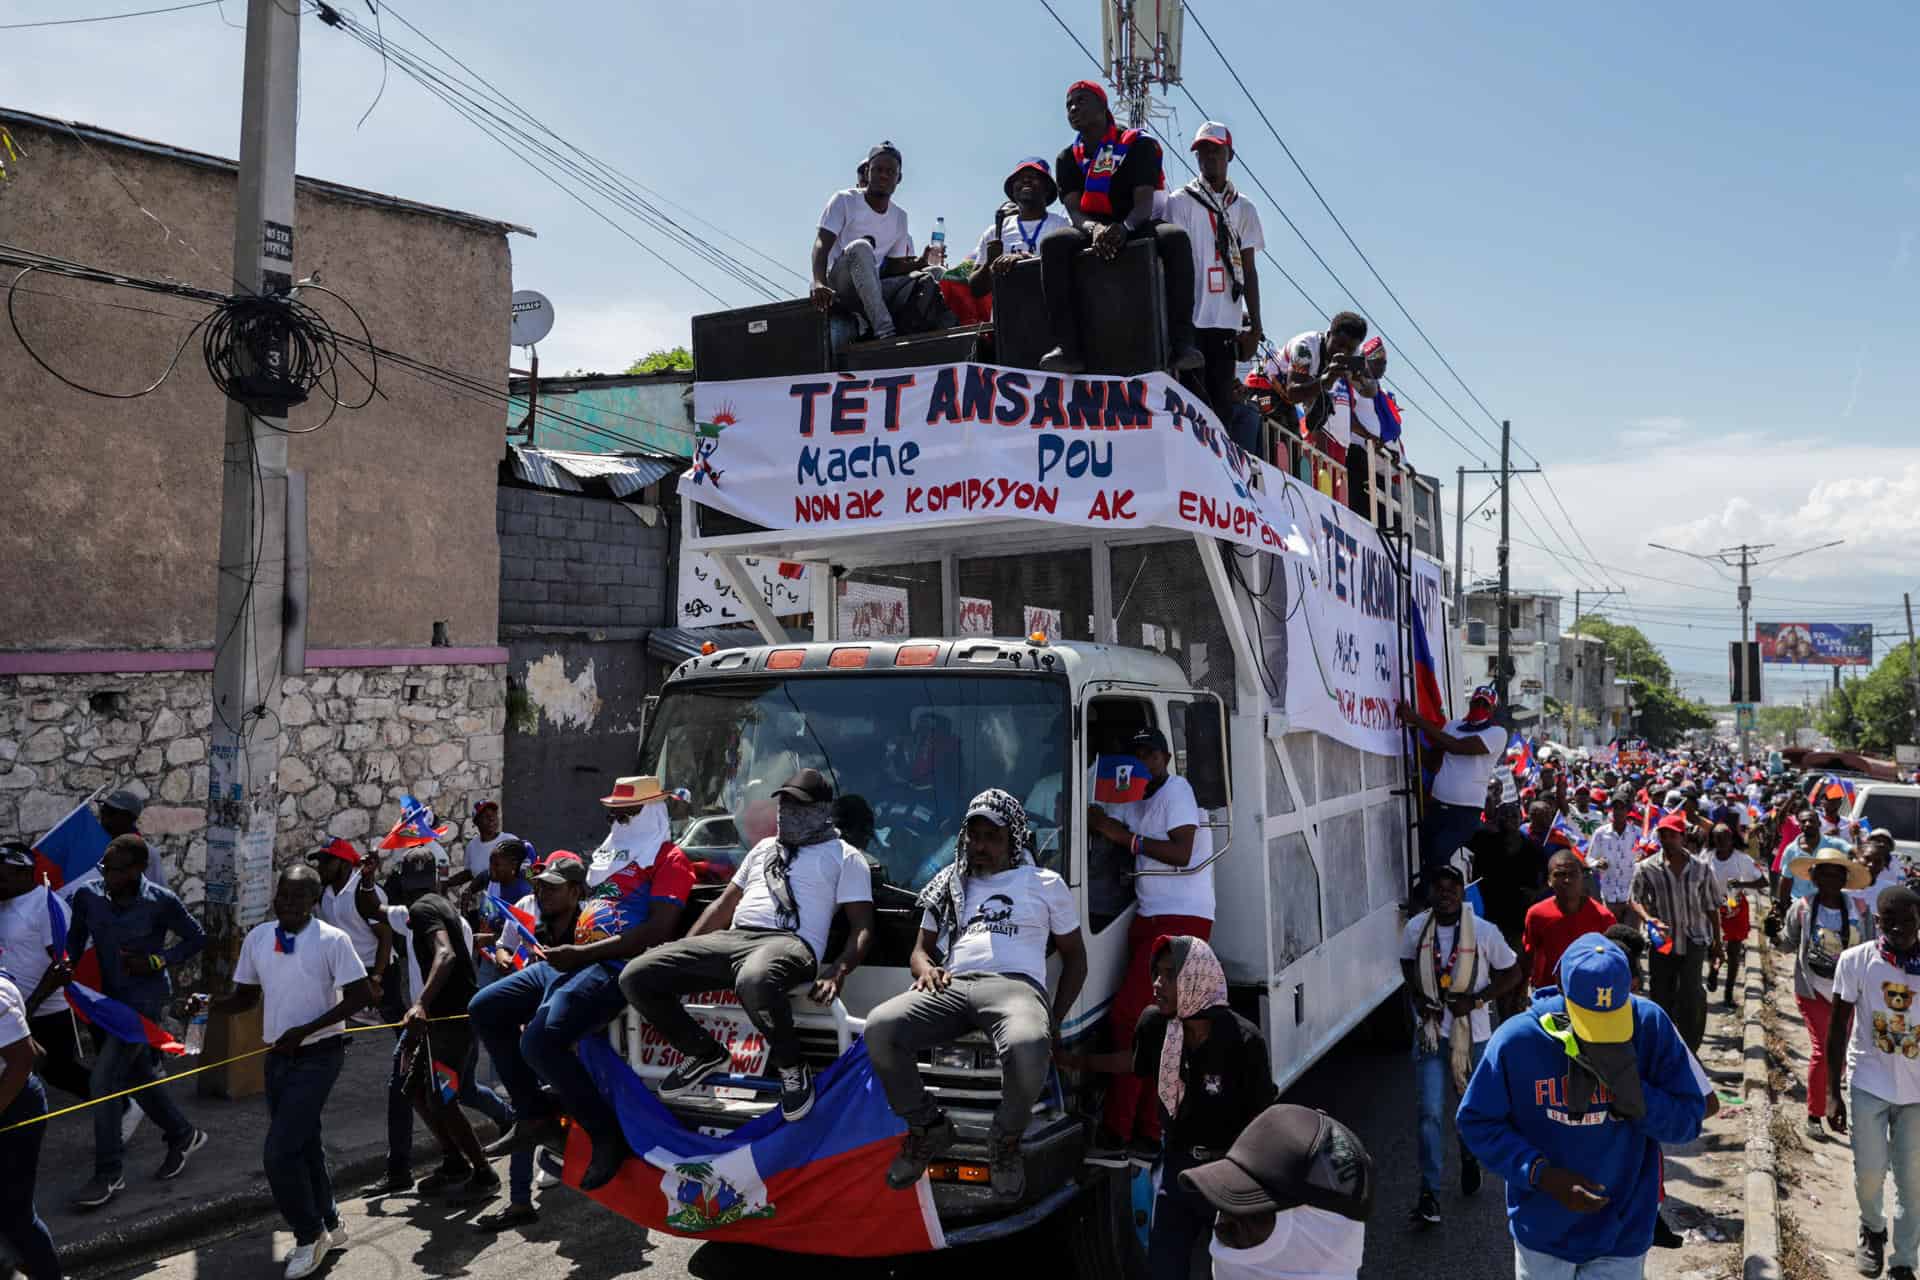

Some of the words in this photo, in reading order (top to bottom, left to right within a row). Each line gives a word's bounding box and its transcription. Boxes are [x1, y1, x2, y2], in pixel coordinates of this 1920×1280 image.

[511, 301, 541, 311] ANAL+
[790, 372, 915, 437] TÈT
[926, 364, 1154, 430] ANSANM
[797, 436, 920, 485] Mache
[795, 493, 840, 523] NON
[1088, 488, 1137, 520] AK
[1595, 986, 1612, 1009] H
[728, 1053, 763, 1073] NOU
